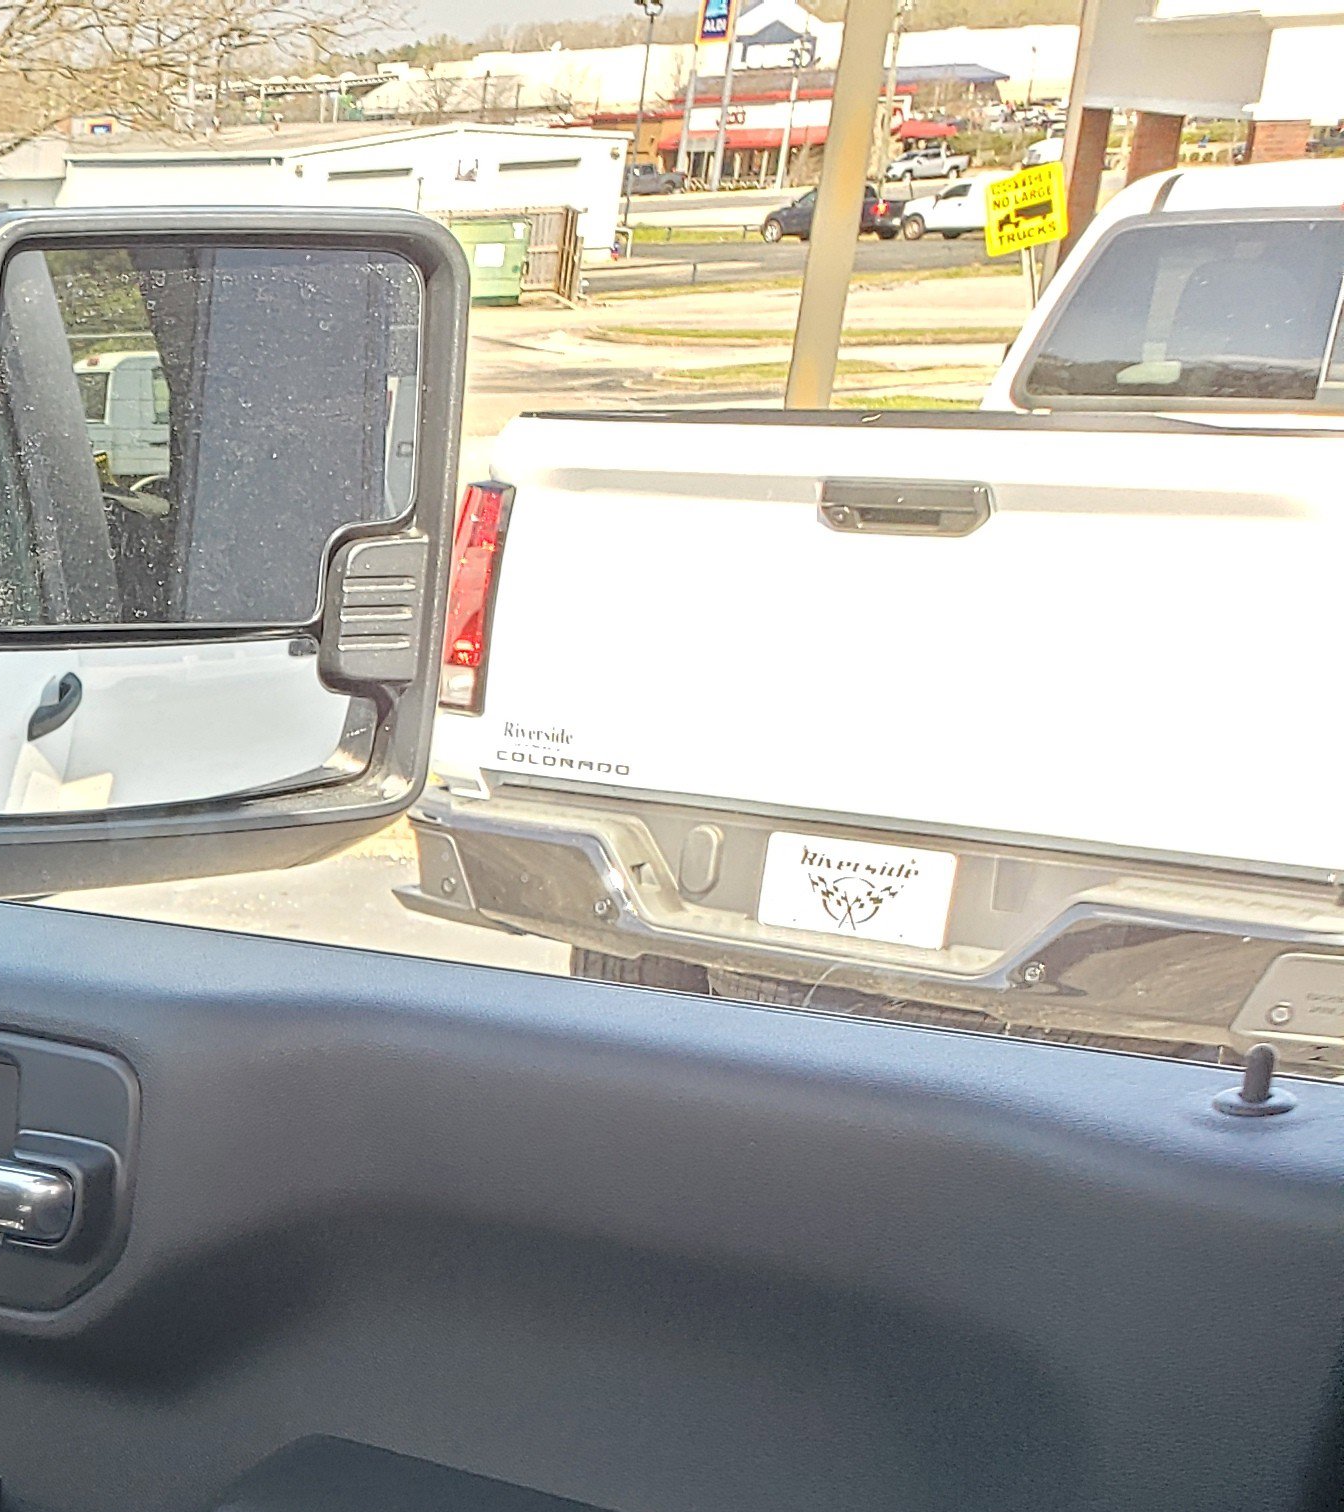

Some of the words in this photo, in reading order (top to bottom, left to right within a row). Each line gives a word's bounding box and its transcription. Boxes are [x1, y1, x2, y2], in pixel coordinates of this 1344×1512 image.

[998, 221, 1057, 246] TRUCKS
[504, 721, 574, 745] Riverside
[496, 750, 631, 776] COLORADO
[800, 845, 920, 879] Riverside
